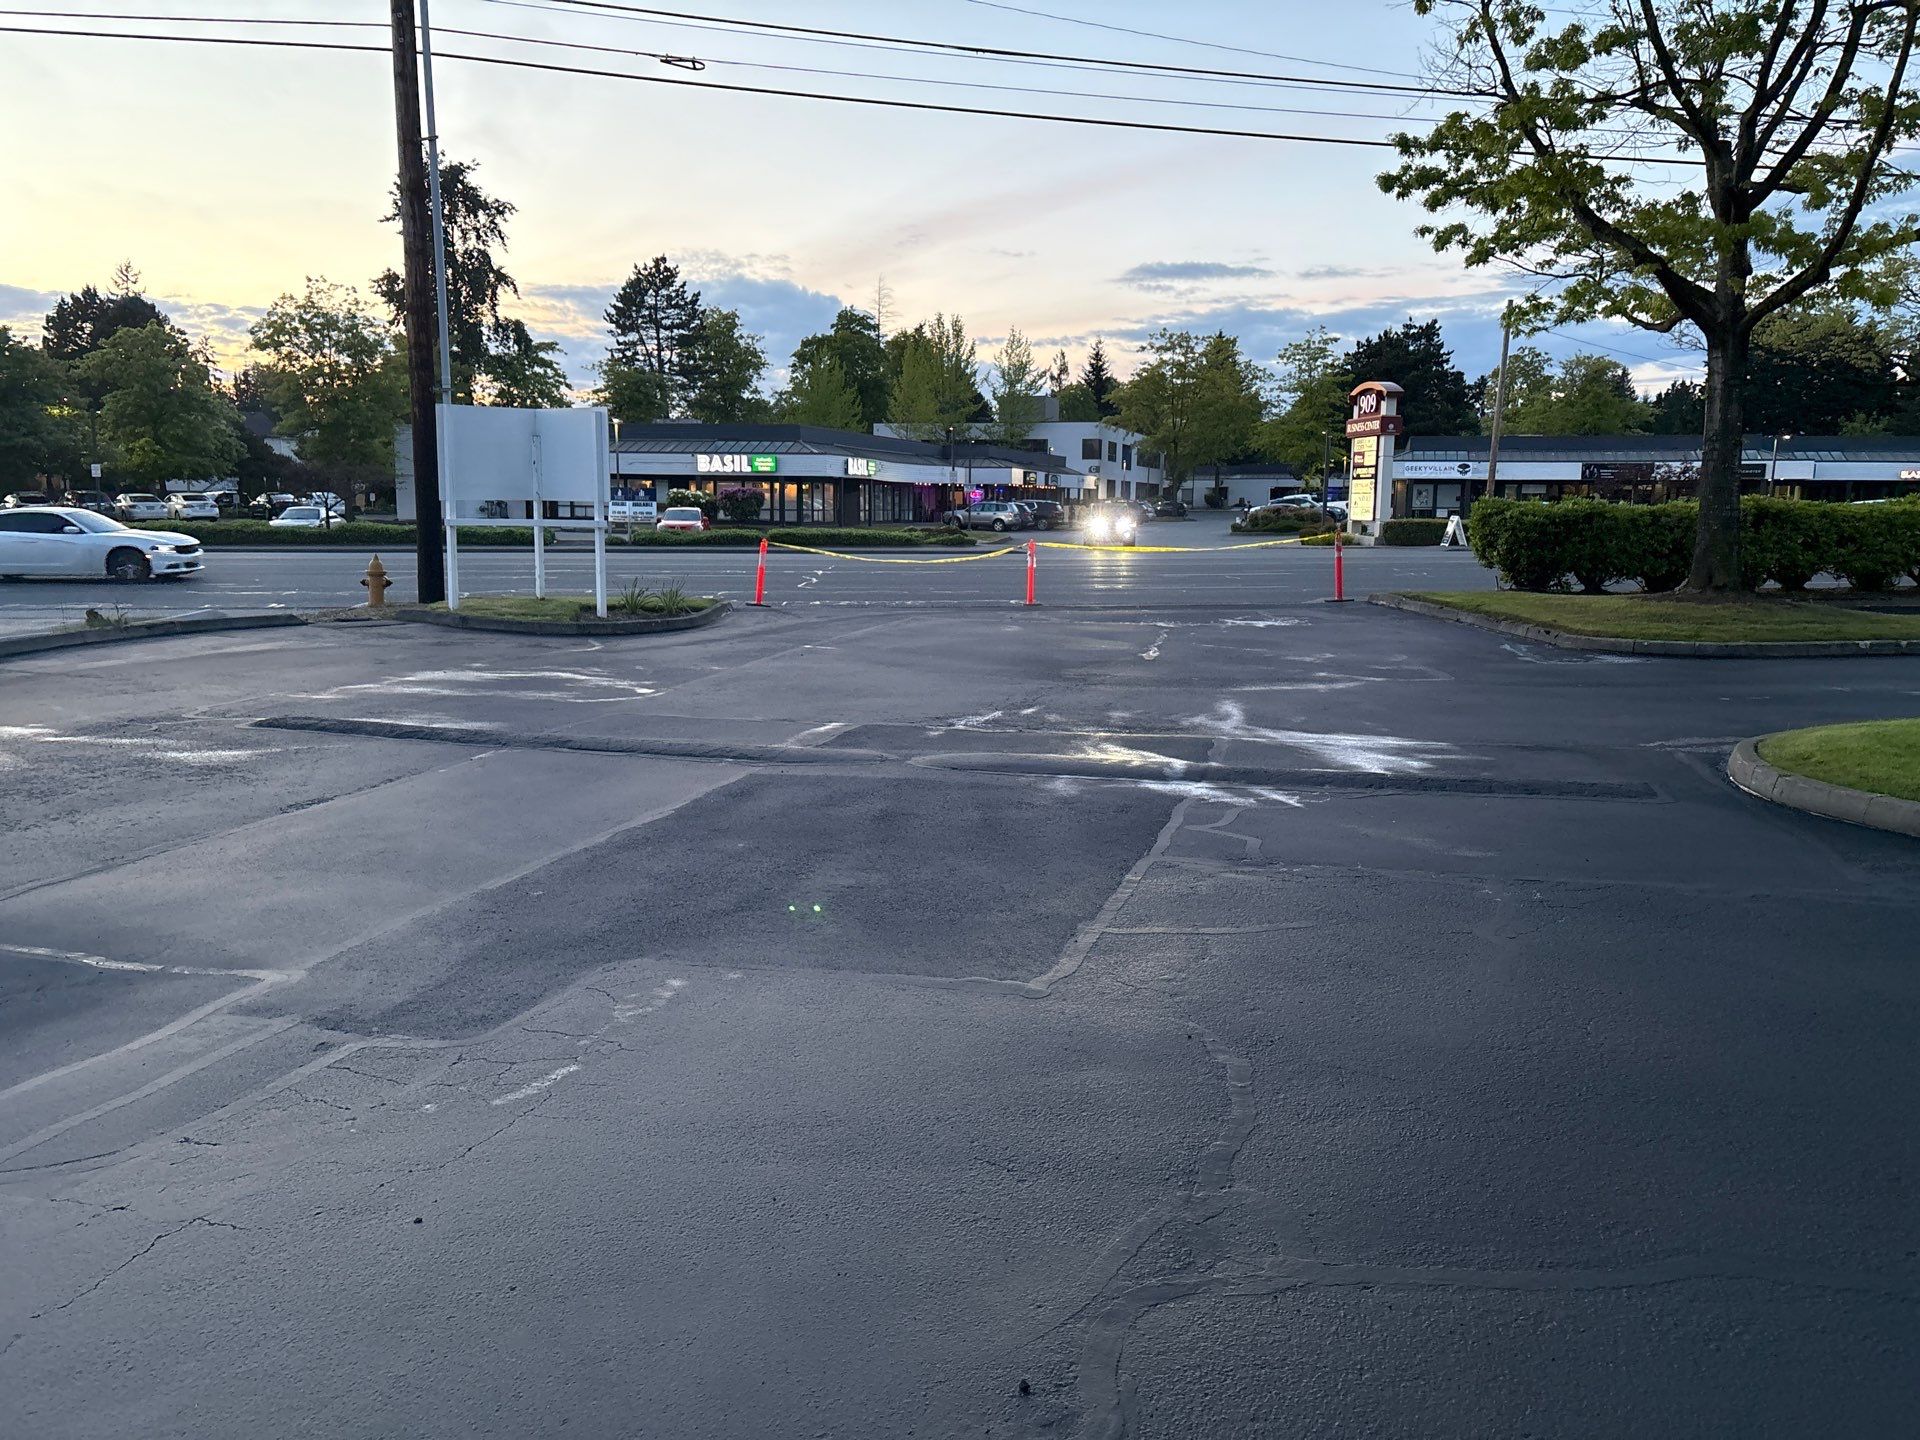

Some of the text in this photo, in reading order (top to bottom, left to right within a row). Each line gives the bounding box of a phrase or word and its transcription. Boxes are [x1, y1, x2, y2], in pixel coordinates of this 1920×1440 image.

[1360, 394, 1376, 414] 909
[1347, 420, 1380, 433] BUSINESS CENTER
[697, 454, 752, 472] BASIL
